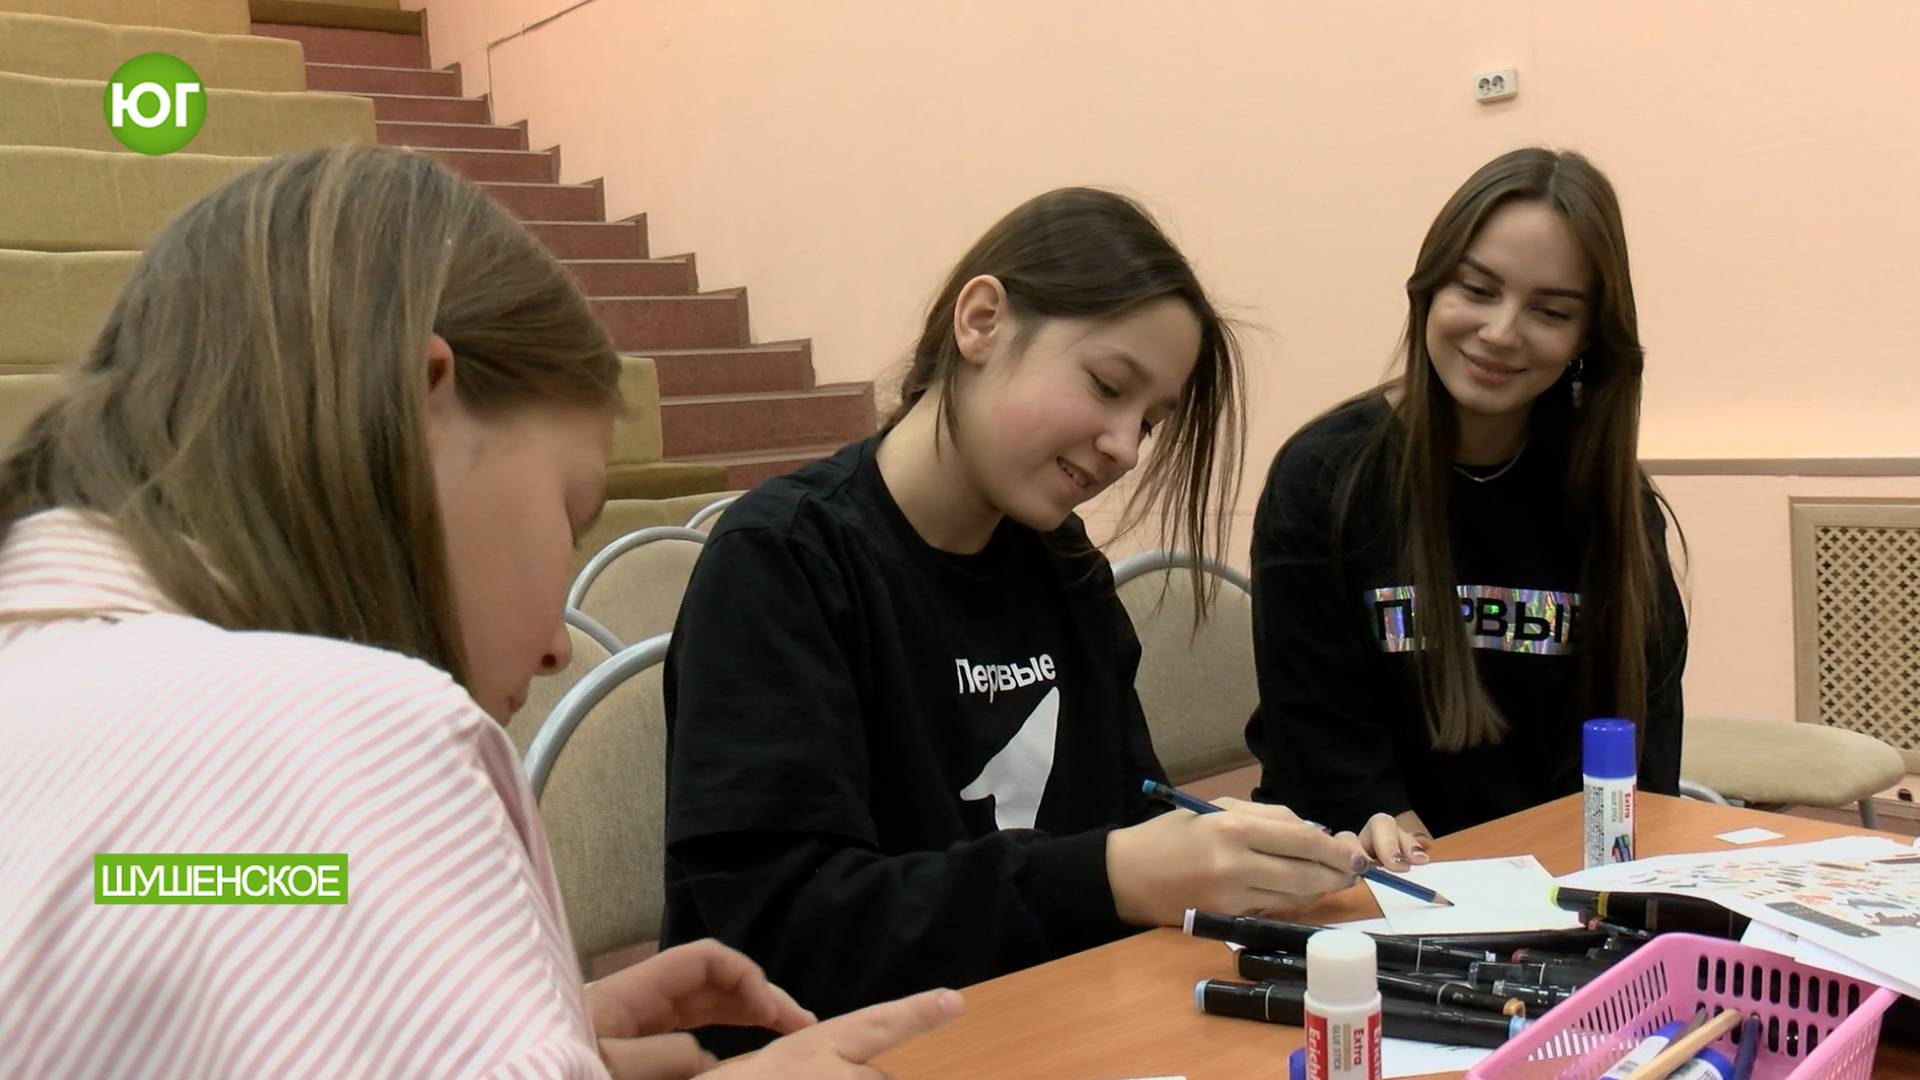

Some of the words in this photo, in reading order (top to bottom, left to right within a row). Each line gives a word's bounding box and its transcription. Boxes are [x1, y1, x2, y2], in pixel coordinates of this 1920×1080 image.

[954, 653, 1056, 704] Первые
[1332, 1025, 1342, 1046] GLUE
[1353, 1028, 1364, 1066] Extra
[1333, 1047, 1342, 1071] STICK
